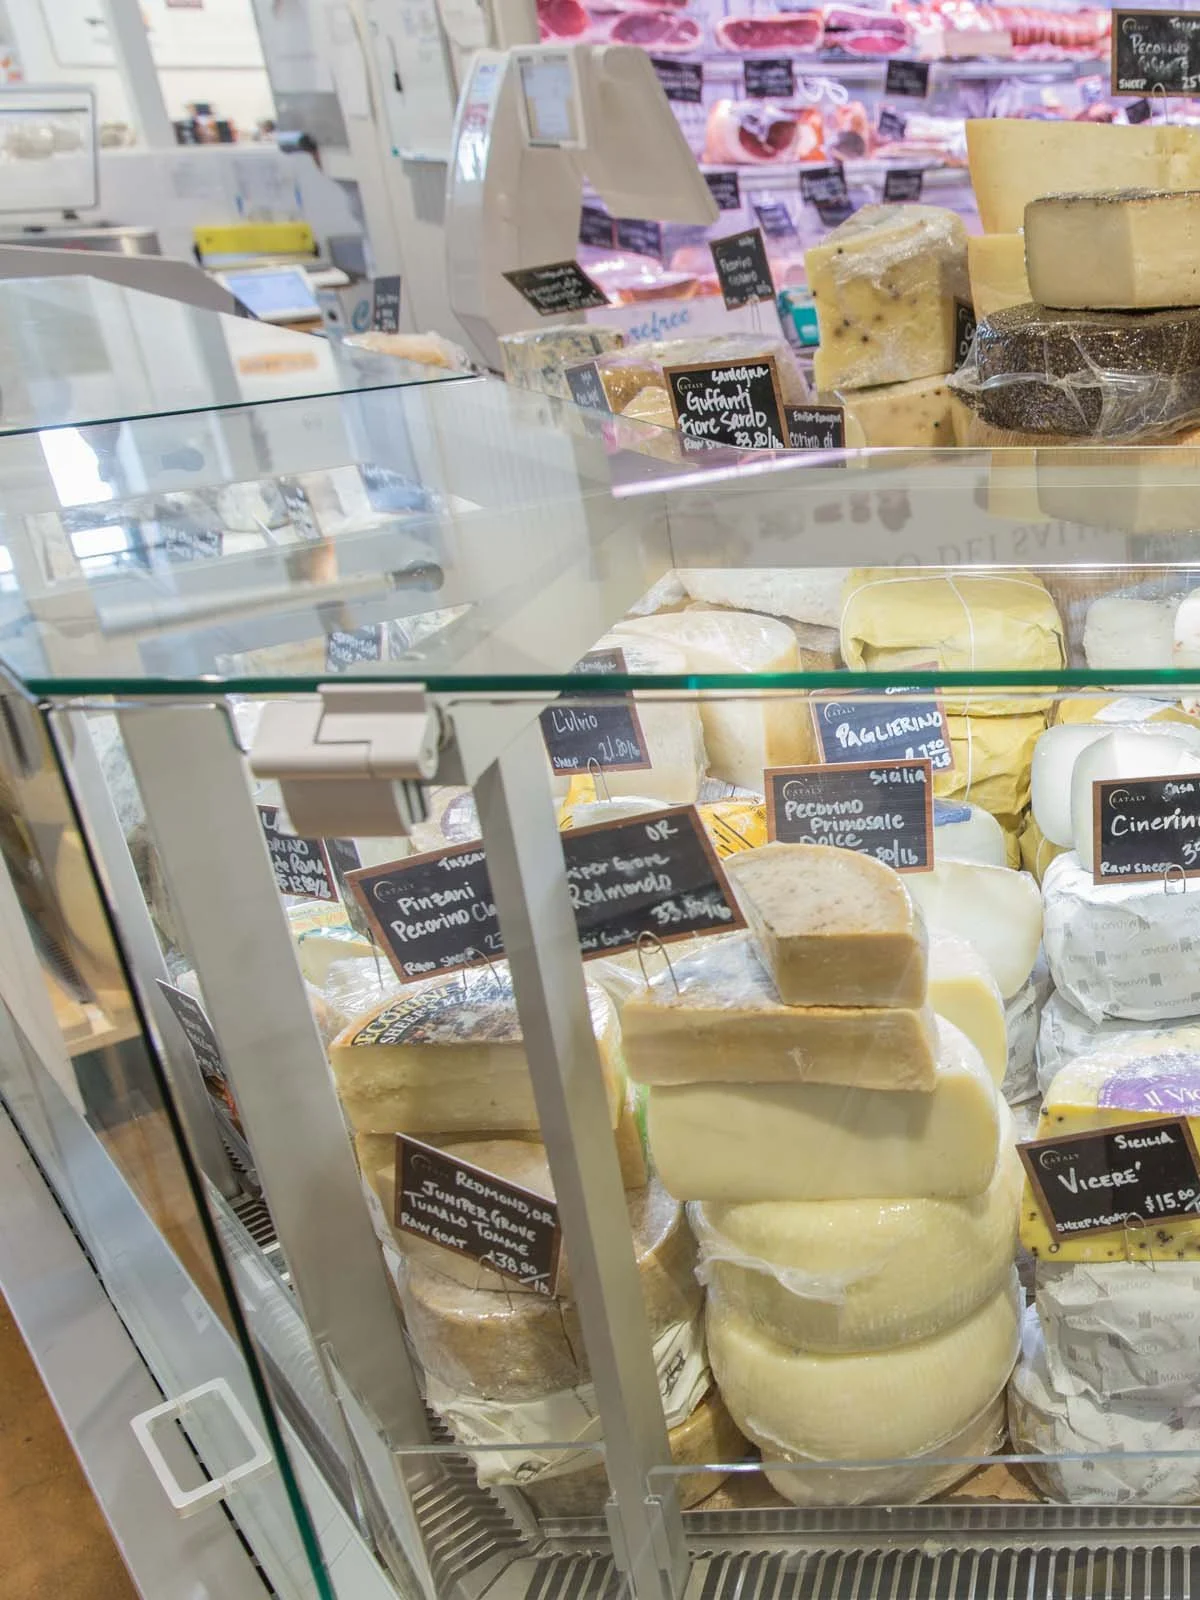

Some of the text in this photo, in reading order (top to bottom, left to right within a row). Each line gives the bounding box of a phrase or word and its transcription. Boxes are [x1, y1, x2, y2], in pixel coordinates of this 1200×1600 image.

[687, 384, 752, 413] Guffanti
[678, 408, 767, 437] Fiore Sardo
[789, 431, 820, 449] corino
[836, 711, 943, 748] PAGLIERINO
[869, 766, 927, 786] Sicilia
[785, 799, 864, 821] Pecorino
[810, 813, 905, 834] Primosale
[398, 881, 475, 916] Pinzani
[390, 908, 470, 943] Pecorino
[403, 1191, 529, 1256] TUMALO TOMME
